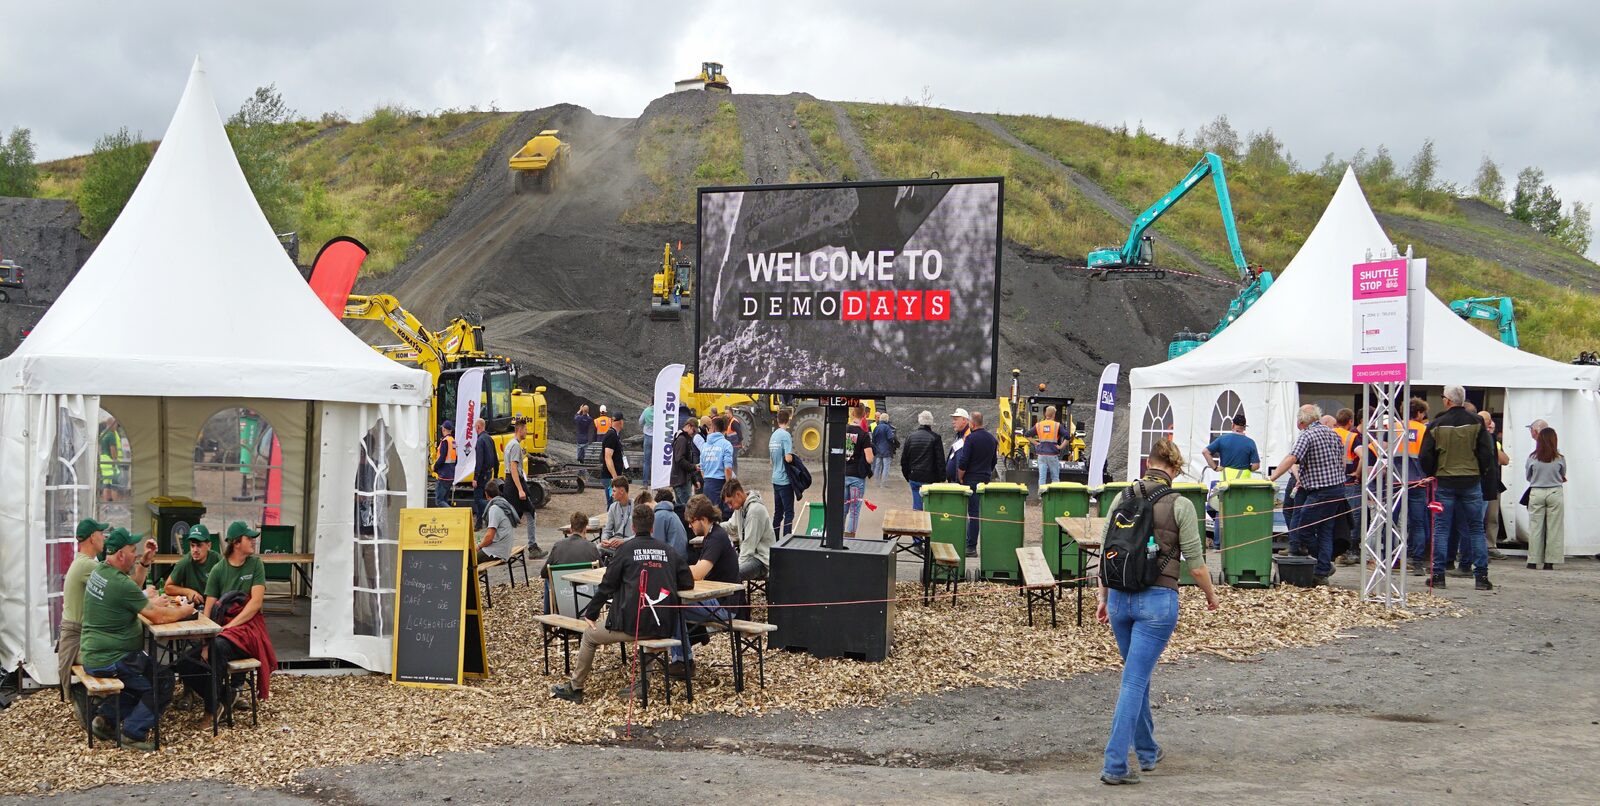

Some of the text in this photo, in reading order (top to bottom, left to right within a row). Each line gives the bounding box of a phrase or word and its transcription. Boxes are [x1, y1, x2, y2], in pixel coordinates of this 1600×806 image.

[746, 250, 943, 282] WELCOME TO
[1360, 268, 1398, 280] SHUTTLE
[1360, 281, 1382, 291] STOP
[397, 328, 422, 354] KOMATSU
[830, 396, 859, 407] LEDify
[466, 400, 475, 440] TRAMAC
[663, 392, 676, 466] KOMATSU
[418, 524, 448, 537] Carlsberg
[416, 632, 435, 648] ONLY
